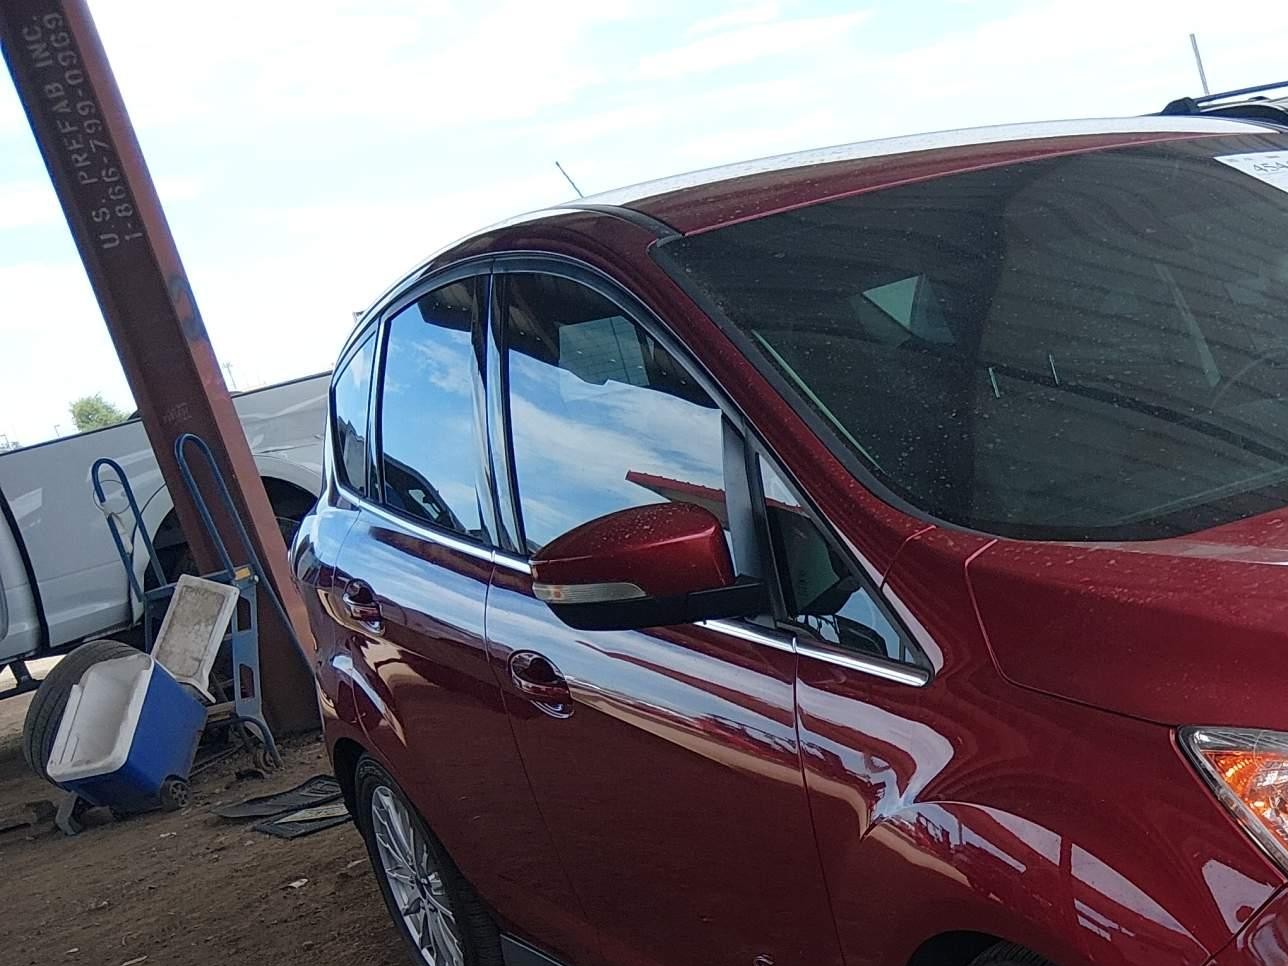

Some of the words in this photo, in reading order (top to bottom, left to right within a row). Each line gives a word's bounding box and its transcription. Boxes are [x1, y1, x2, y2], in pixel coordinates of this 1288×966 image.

[22, 16, 53, 68] INC.
[44, 82, 99, 185] PREFAB
[92, 199, 120, 248] U.S.
